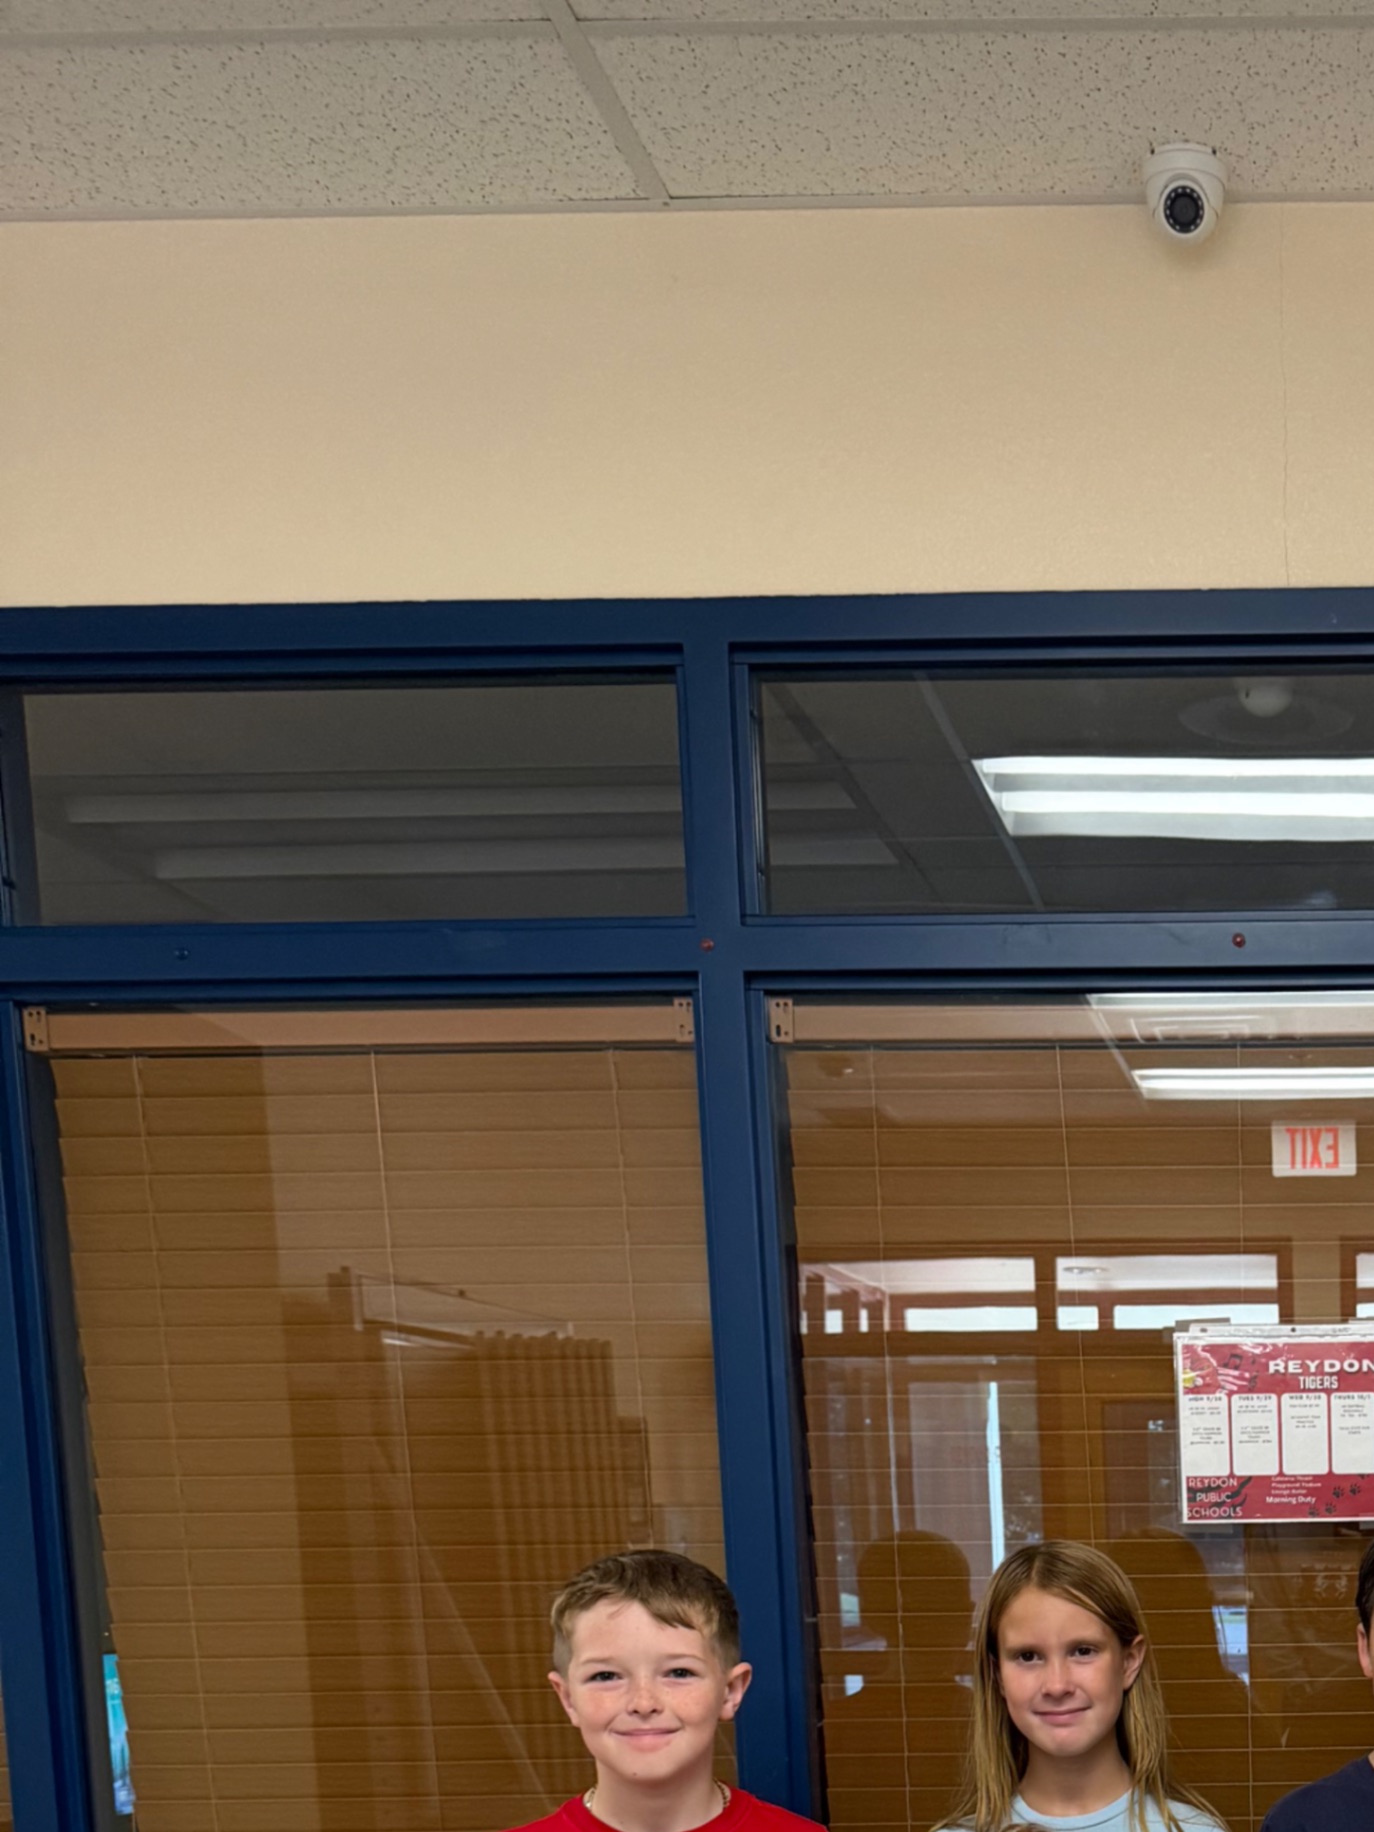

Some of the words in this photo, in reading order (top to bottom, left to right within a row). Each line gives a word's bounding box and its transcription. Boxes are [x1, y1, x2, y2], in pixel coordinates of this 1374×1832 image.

[1299, 1375, 1339, 1389] TIGERS
[1189, 1477, 1237, 1487] REYDON
[1196, 1492, 1232, 1502] PUBLIC
[1265, 1496, 1297, 1504] Morning
[1298, 1495, 1316, 1504] Duty
[1186, 1506, 1243, 1517] SCHOOLS
